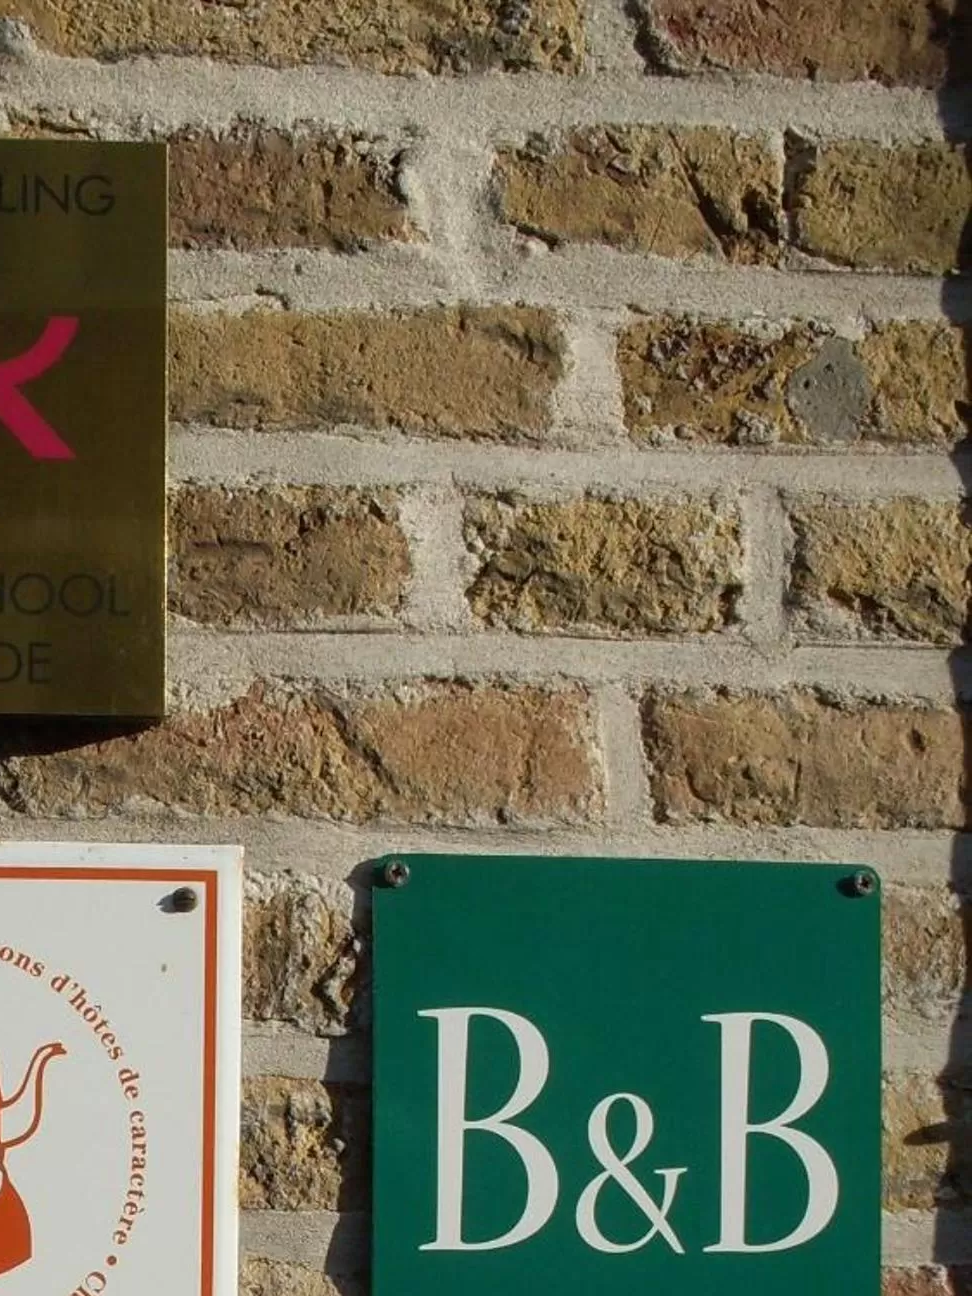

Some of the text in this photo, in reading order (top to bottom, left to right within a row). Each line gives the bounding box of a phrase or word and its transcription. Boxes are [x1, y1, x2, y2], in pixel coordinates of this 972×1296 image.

[50, 975, 125, 1061] d'hôtes
[118, 1067, 140, 1100] de
[417, 1006, 840, 1256] B&B
[112, 1110, 147, 1245] caractère
